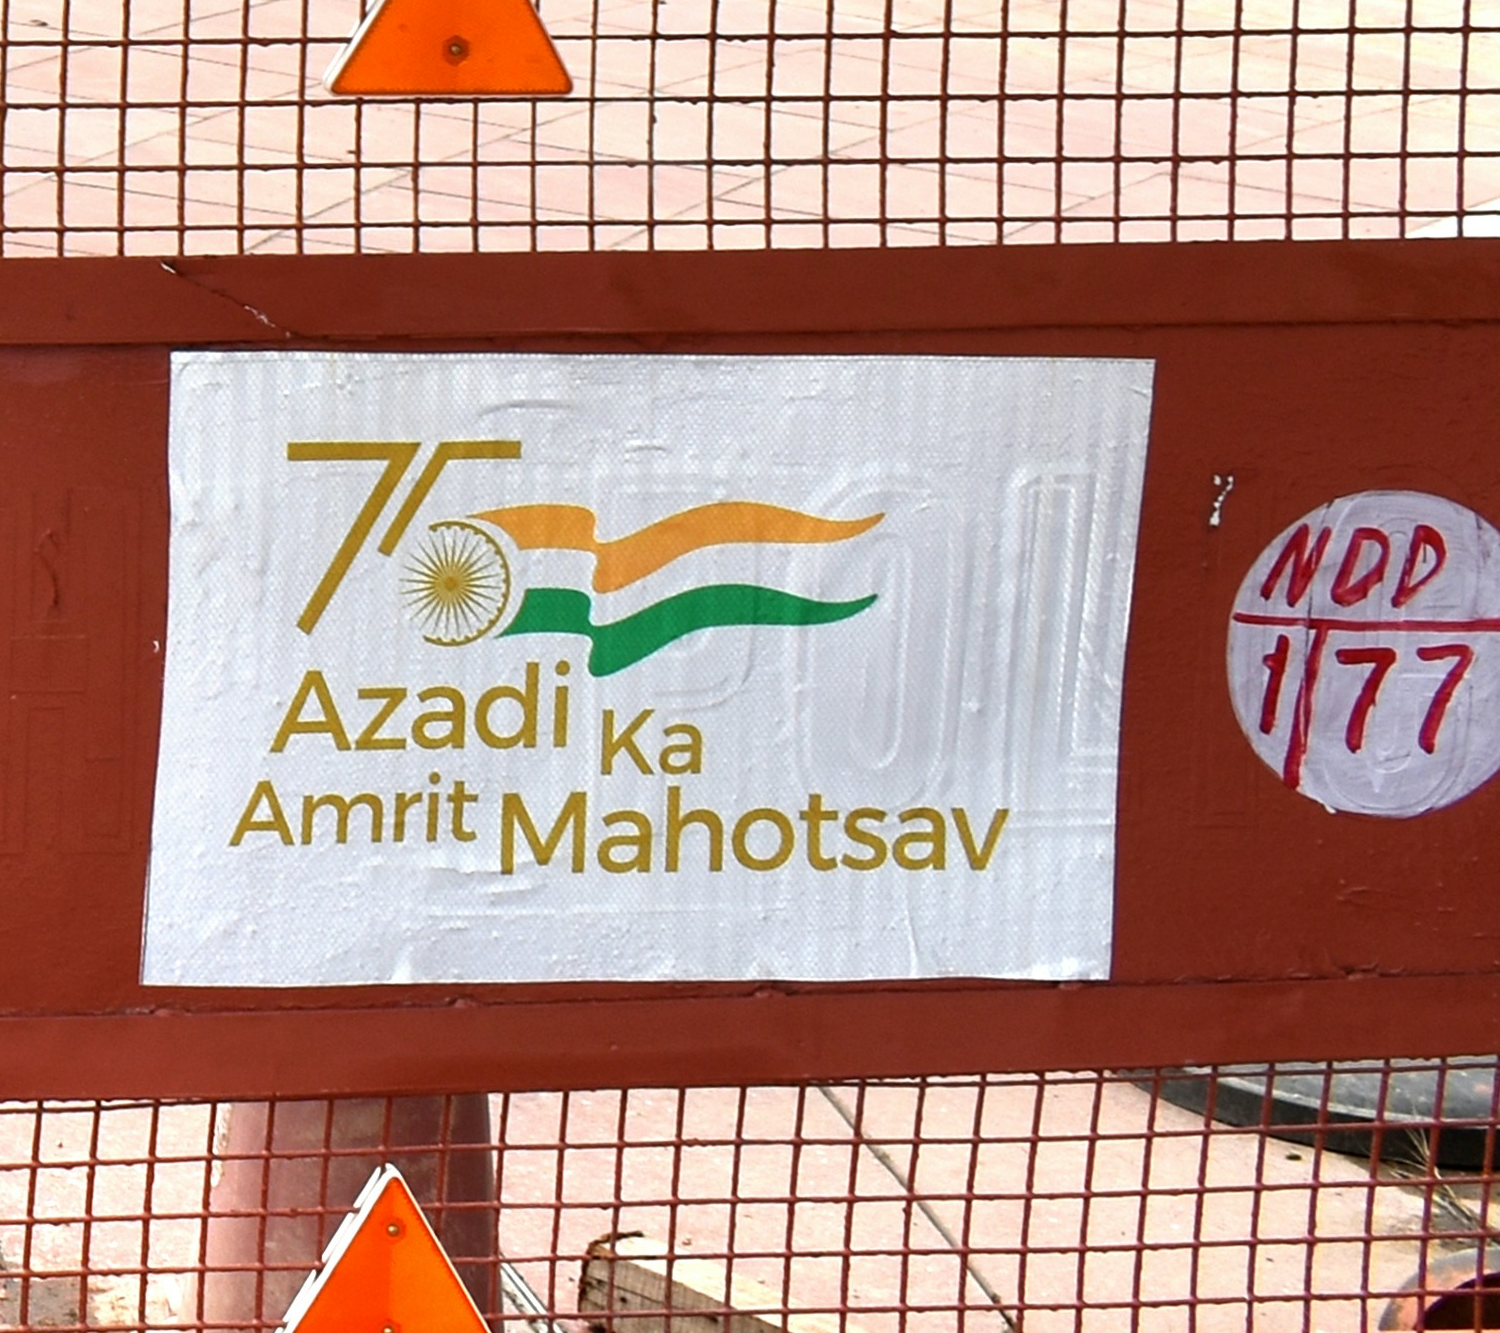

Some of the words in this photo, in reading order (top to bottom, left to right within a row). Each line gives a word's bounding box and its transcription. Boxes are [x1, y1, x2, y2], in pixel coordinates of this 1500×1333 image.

[1260, 523, 1447, 608] NDD
[271, 661, 570, 753] Azadi
[600, 708, 704, 775] Ka
[230, 773, 478, 847] Amrit
[500, 788, 1010, 875] Mahotsav
